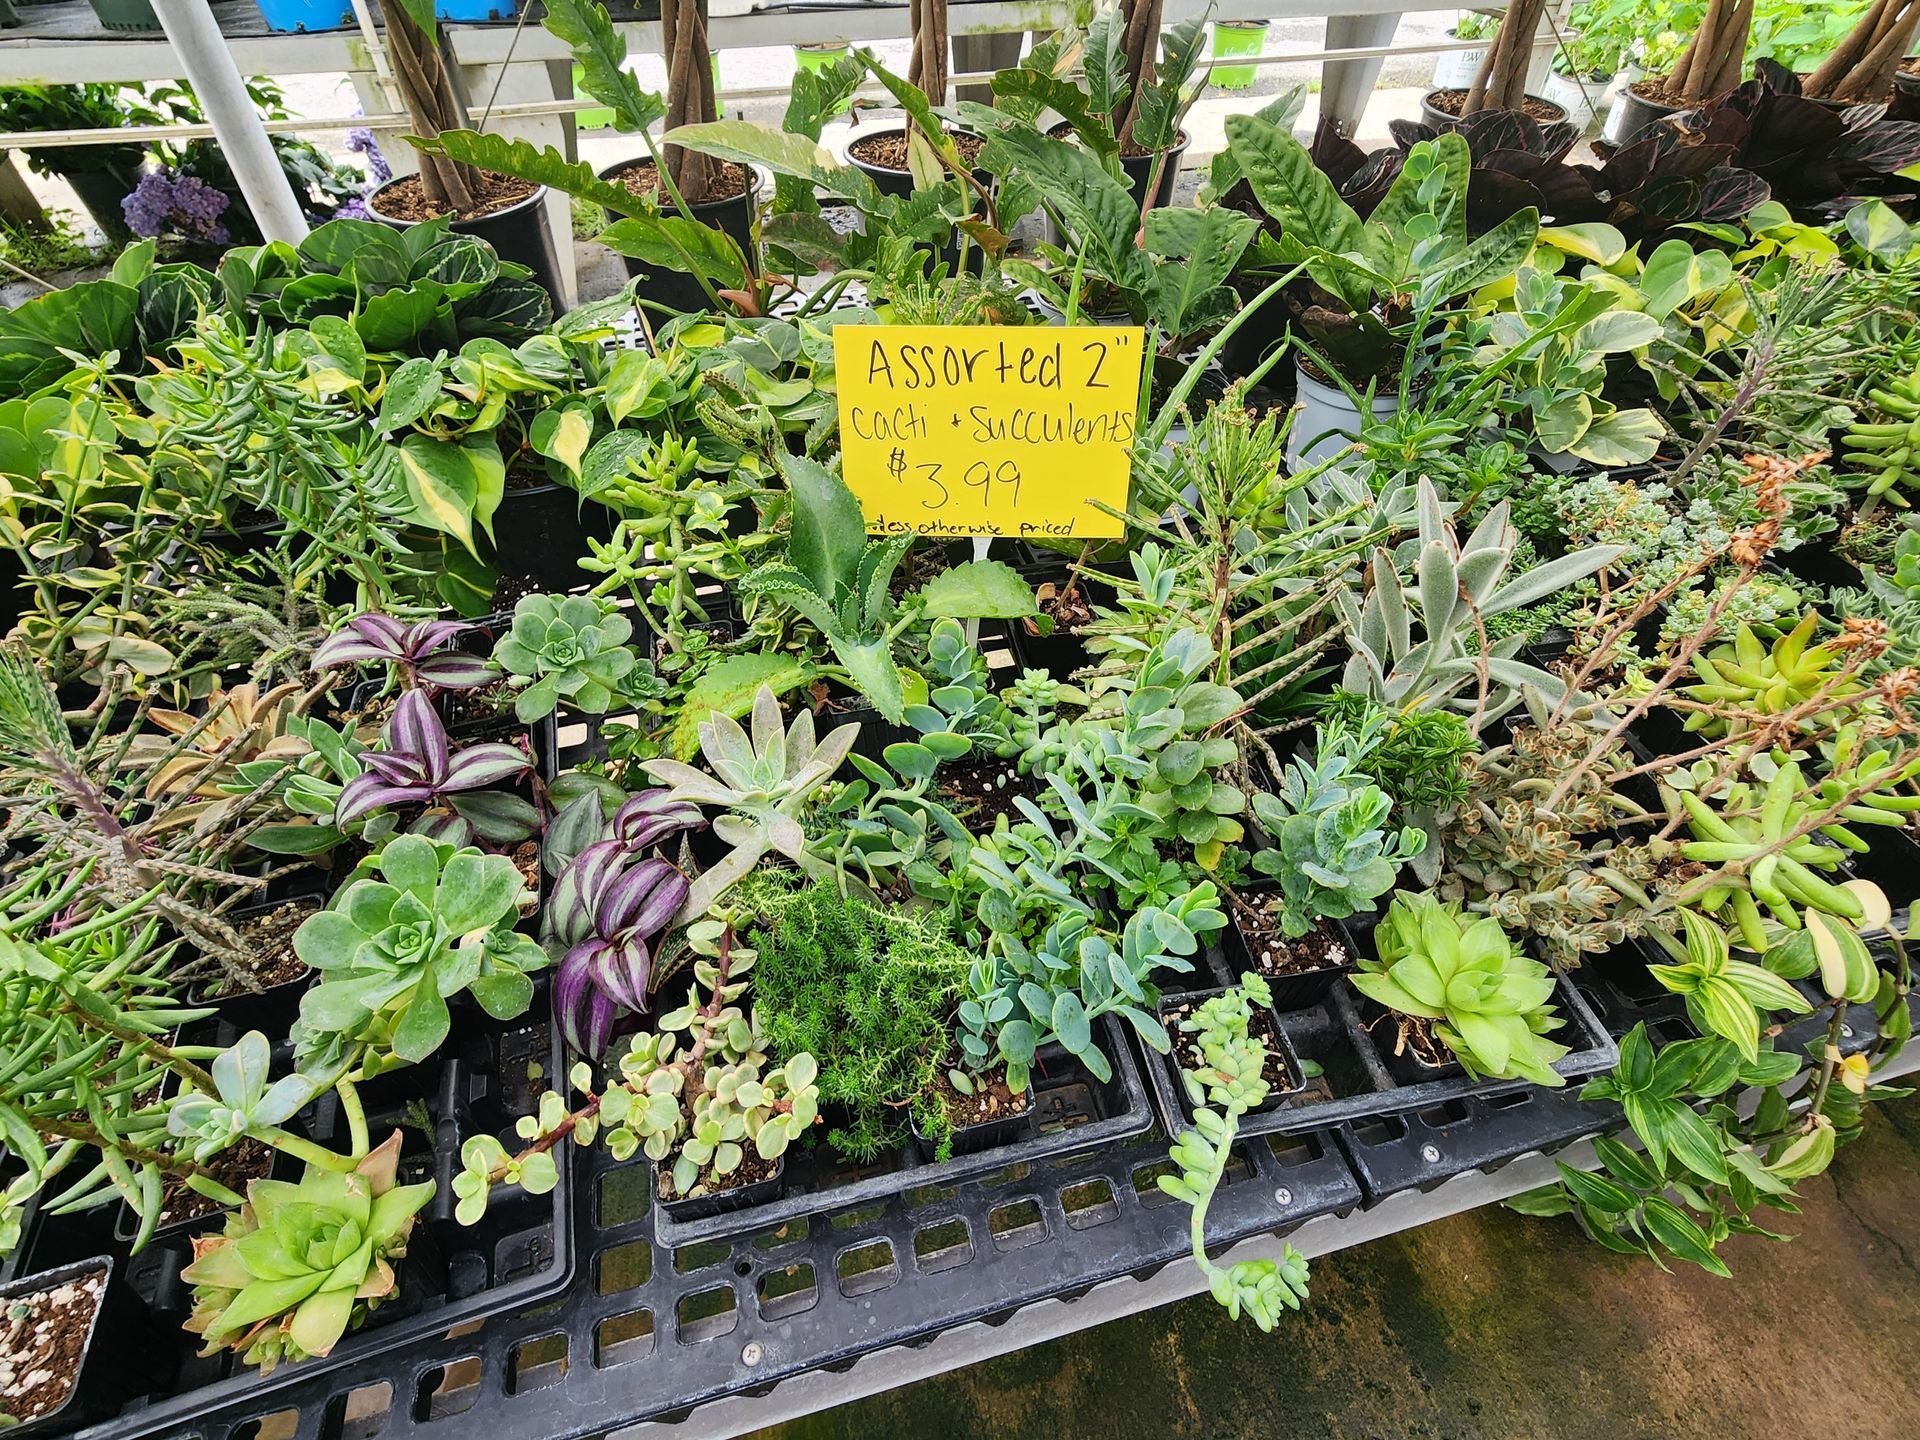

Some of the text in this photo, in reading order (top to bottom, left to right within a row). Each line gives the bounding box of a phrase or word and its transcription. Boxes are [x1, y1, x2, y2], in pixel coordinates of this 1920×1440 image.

[869, 335, 1129, 390] Assorted 2"
[1018, 517, 1076, 537] priced
